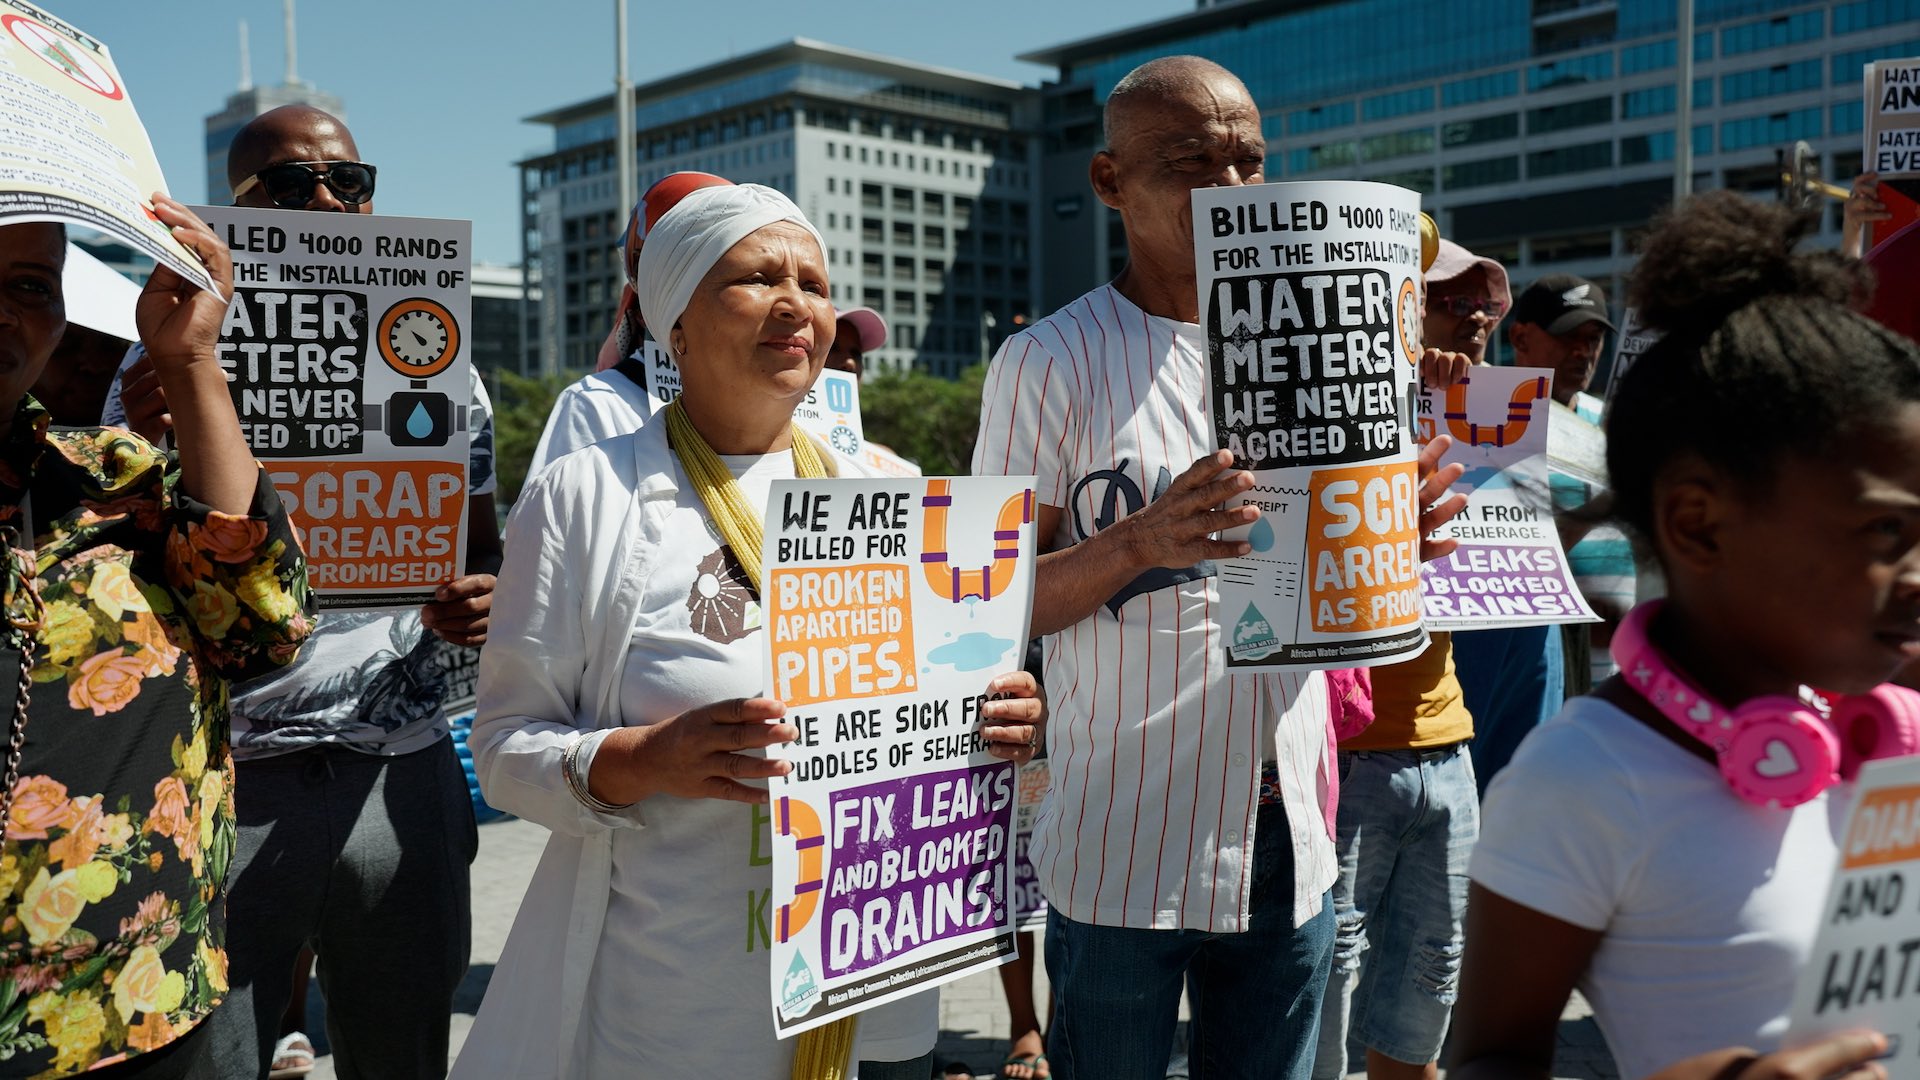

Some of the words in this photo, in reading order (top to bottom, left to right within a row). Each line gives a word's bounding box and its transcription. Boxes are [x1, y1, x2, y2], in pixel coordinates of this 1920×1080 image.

[1211, 201, 1328, 238] BILLED
[1339, 205, 1383, 230] 4000
[299, 232, 363, 256] 4000
[376, 236, 458, 260] RANDS
[1213, 246, 1260, 272] FOR
[1270, 243, 1314, 267] THE
[1324, 241, 1410, 264] INSTALLATION
[280, 263, 426, 287] INSTALLATION
[436, 270, 465, 289] OF
[1217, 272, 1390, 338] WATER
[1222, 329, 1395, 386] METERS
[242, 387, 358, 420] NEVER
[793, 408, 823, 420] TION.
[1224, 390, 1278, 428] WE
[1295, 380, 1396, 420] NEVER
[304, 423, 360, 450] TO?
[1227, 424, 1346, 462] AGREED
[1358, 420, 1399, 452] TO?
[267, 470, 462, 520] SCRAP
[782, 490, 832, 533] WE
[847, 491, 911, 531] ARE
[1482, 505, 1538, 522] FROM
[298, 524, 451, 558] REARS
[778, 535, 855, 563] BILLED
[866, 533, 907, 559] FOR
[1450, 526, 1547, 540] SEWERAGE.
[1449, 549, 1558, 574] LEAKS
[778, 569, 904, 611] BROKEN
[1429, 576, 1564, 595] BLOCKED
[775, 606, 903, 643] APARTHEID
[1317, 597, 1357, 627] AS
[777, 639, 916, 701] PIPES.
[1290, 648, 1317, 659] African
[1317, 646, 1339, 657] Water
[835, 708, 882, 743] ARE
[895, 699, 949, 734] SICK
[962, 692, 1014, 725] FR
[888, 742, 914, 769] OF
[833, 791, 897, 850] FIX
[911, 767, 1013, 831] LEAKS
[830, 863, 878, 898] AND
[880, 824, 1005, 891] BLOCKED
[1832, 871, 1905, 925] AND
[829, 862, 1005, 972] DRAINS!
[827, 991, 849, 1007] African
[848, 986, 865, 1000] Water
[864, 977, 890, 996] Commons
[889, 969, 916, 987] Collective
[1813, 938, 1920, 1017] WAT
